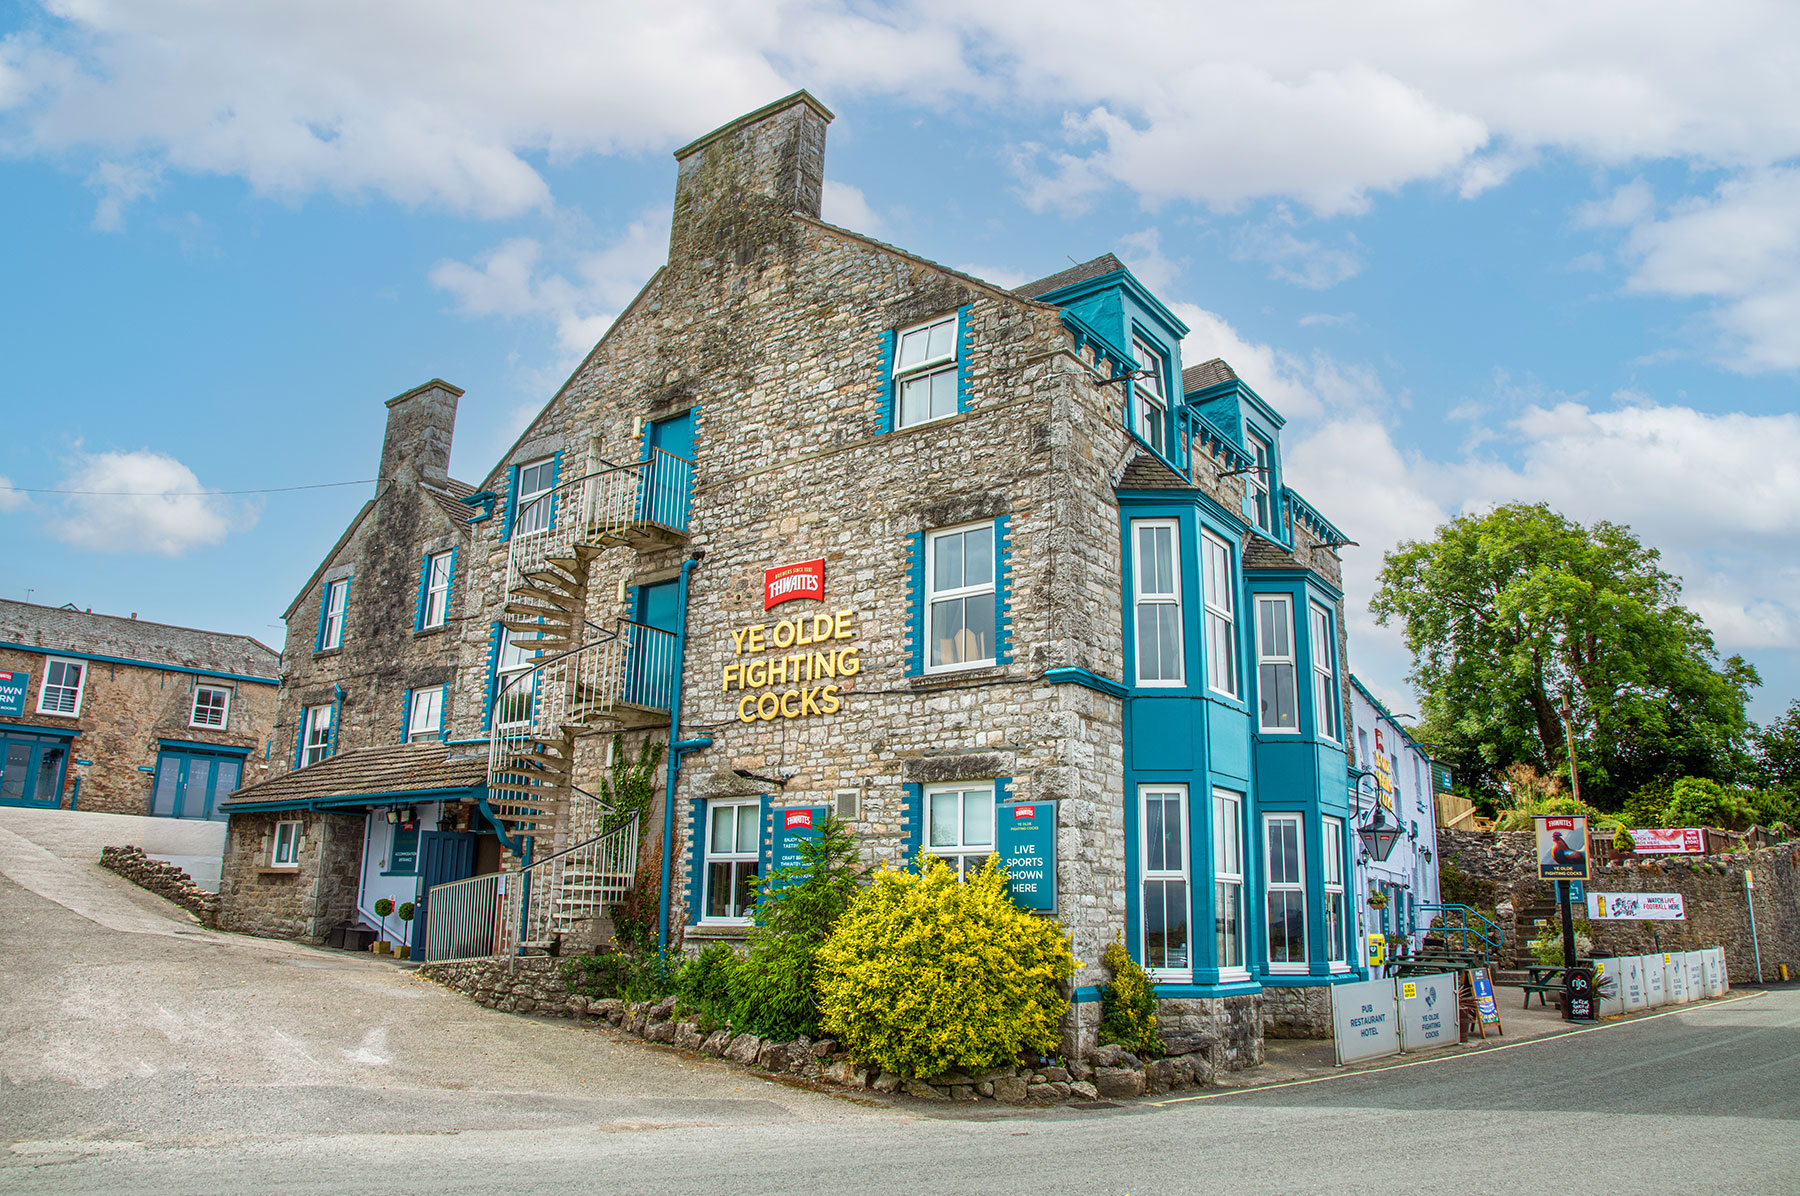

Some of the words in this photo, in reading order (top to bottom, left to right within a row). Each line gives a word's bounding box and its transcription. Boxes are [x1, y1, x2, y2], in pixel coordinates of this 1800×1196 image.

[768, 574, 818, 599] THWAITES
[731, 624, 765, 655] YE
[773, 609, 853, 648] OLDE
[722, 646, 860, 691] FIGHTING
[738, 684, 840, 722] COCKS
[787, 815, 811, 825] THWAITES
[1014, 844, 1036, 855] LIVE
[1006, 857, 1043, 867] SPORTS
[1006, 870, 1043, 880] SHOWN
[1012, 883, 1038, 893] HERE
[1361, 1004, 1373, 1013] PUB
[1350, 1013, 1386, 1027] RESTAURANT
[1421, 1021, 1441, 1030] FIGHTING
[1360, 1027, 1379, 1037] HOTEL
[1425, 1030, 1440, 1039] COCKS
